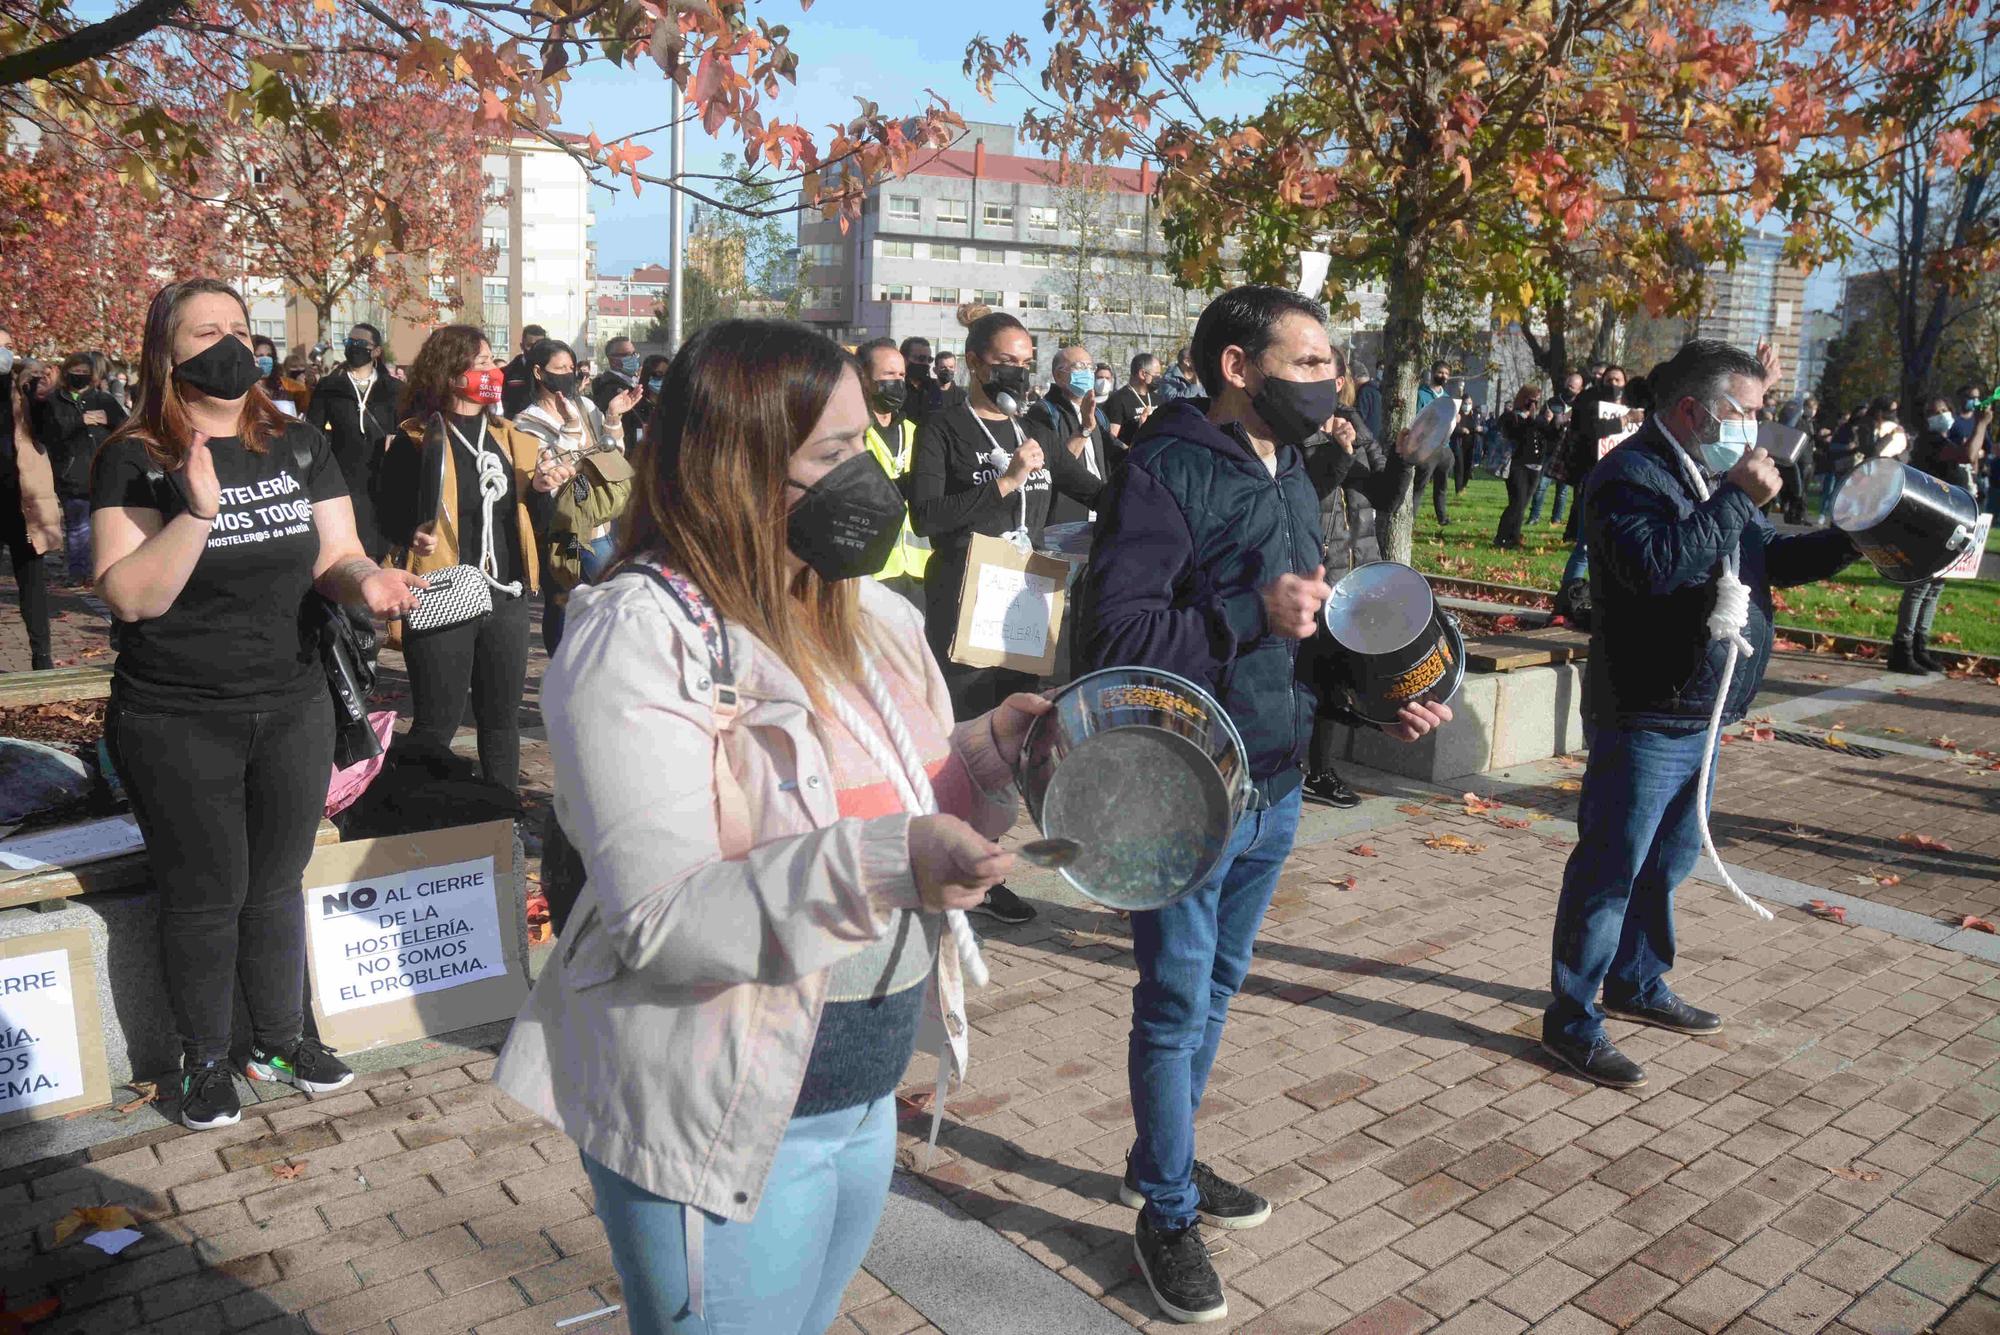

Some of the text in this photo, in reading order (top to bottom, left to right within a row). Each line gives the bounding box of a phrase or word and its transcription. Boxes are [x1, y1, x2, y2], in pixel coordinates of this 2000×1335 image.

[218, 470, 300, 505] STELERÍA
[207, 522, 310, 548] HOSTELER@S de MARÍN
[208, 511, 255, 533] MOS
[322, 872, 484, 916] NO AL CIERRE
[379, 905, 439, 929] DE LA
[345, 919, 474, 957] HOSTELERÍA.
[358, 940, 467, 976] NO SOMOS
[340, 957, 488, 1000] EL PROBLEMA.
